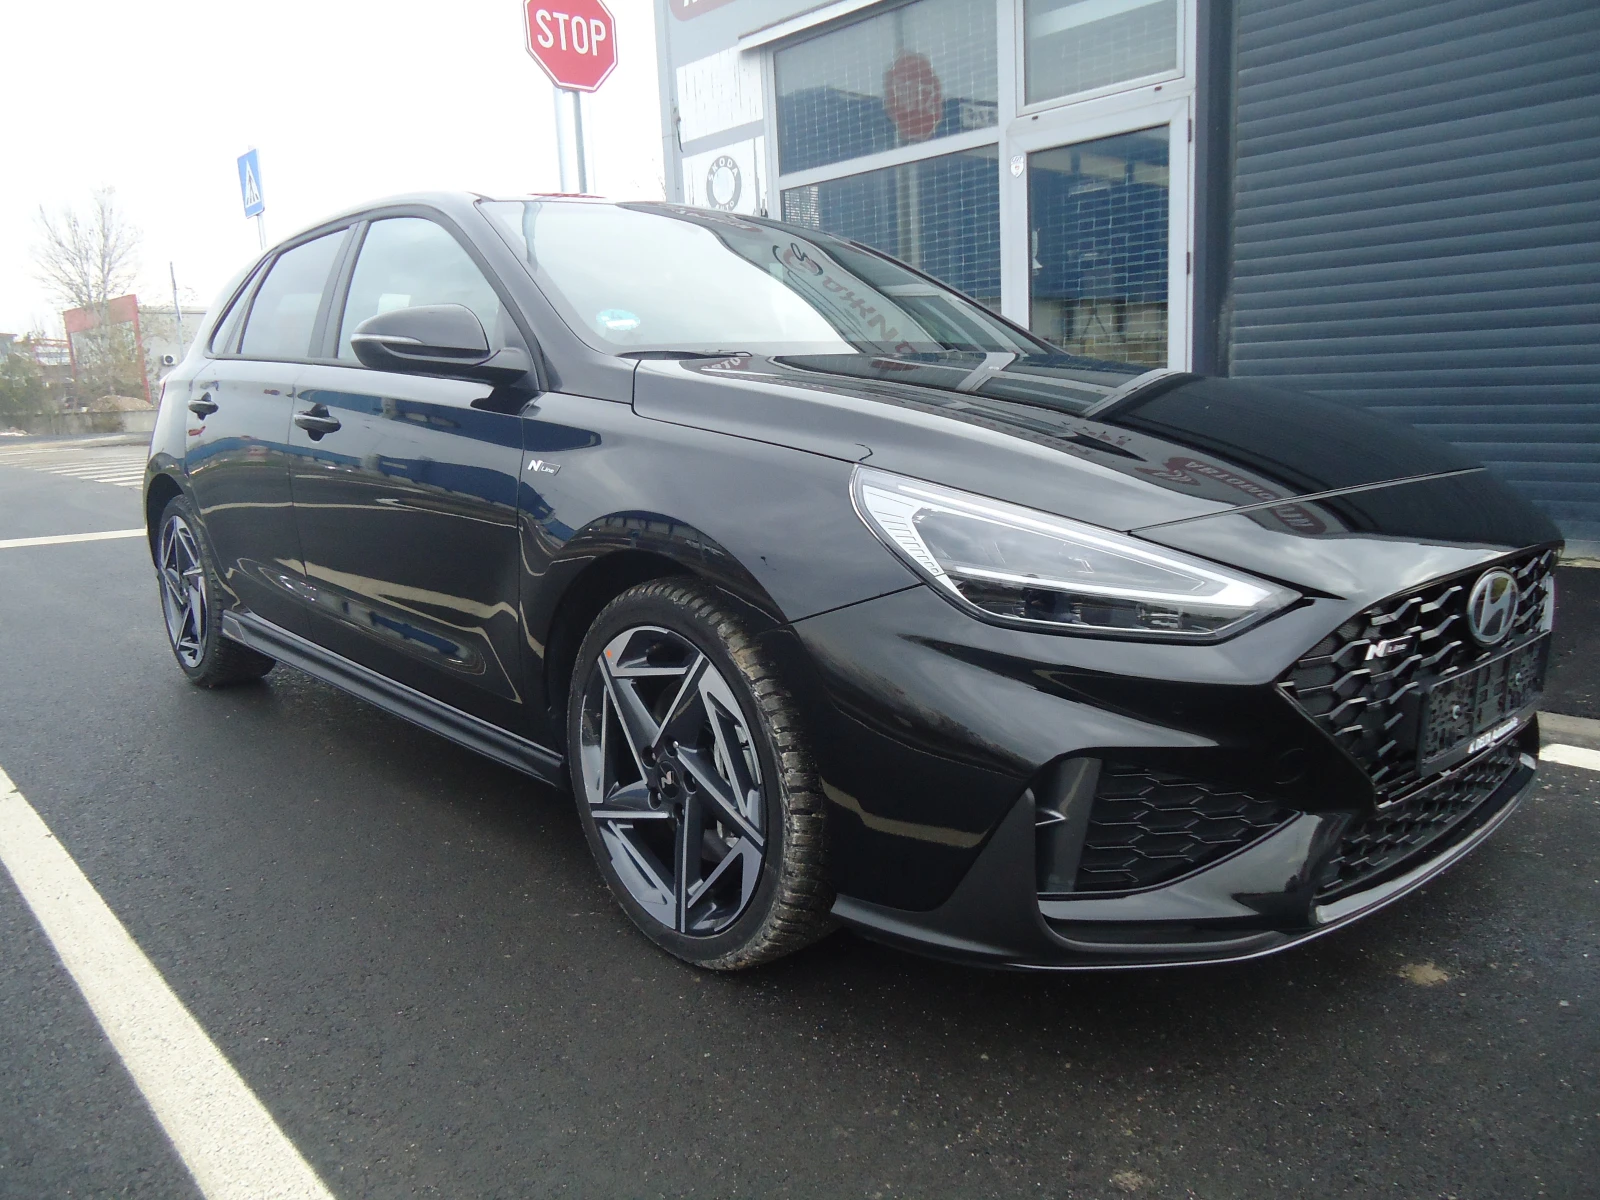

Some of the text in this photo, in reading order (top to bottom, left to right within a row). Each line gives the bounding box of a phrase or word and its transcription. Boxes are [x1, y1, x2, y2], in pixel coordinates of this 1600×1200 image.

[535, 9, 606, 56] STOP
[527, 459, 543, 472] N
[1364, 639, 1388, 661] N
